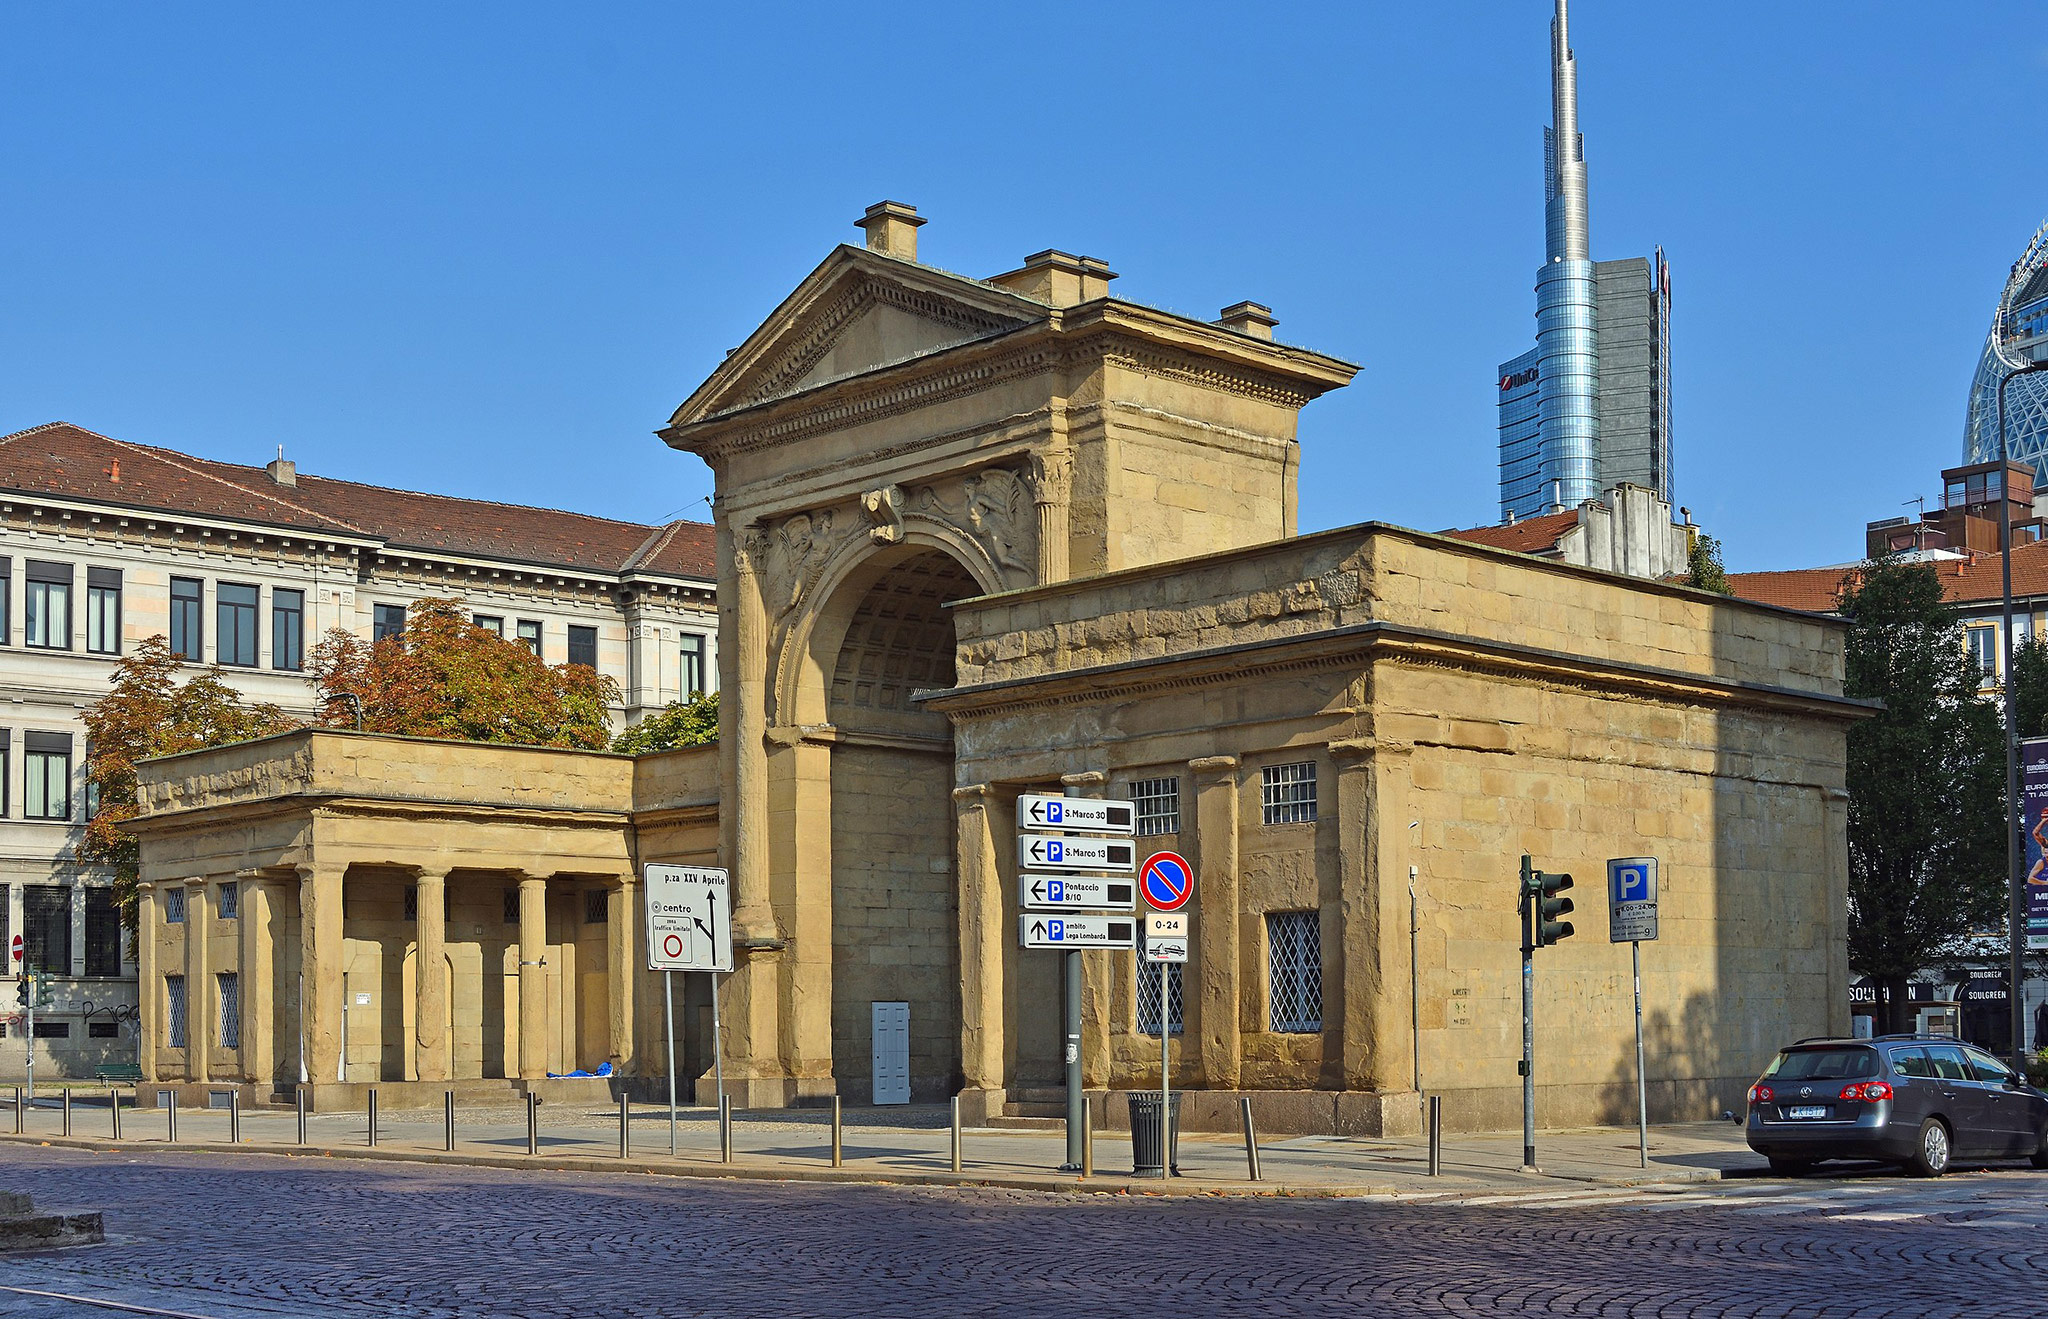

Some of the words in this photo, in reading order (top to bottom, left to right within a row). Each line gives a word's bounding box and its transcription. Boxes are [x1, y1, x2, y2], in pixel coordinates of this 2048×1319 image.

[1051, 805, 1060, 819] P
[1095, 811, 1106, 820] 30
[1051, 845, 1060, 859] P
[1097, 850, 1106, 858] 13
[664, 874, 680, 883] p.za
[683, 872, 698, 883] XXV
[702, 874, 725, 886] Aprile
[1620, 869, 1641, 898] P
[1051, 884, 1061, 898] P
[1065, 883, 1099, 891] Pontaccio
[1065, 893, 1082, 901] 8/10
[663, 903, 692, 913] centro
[1052, 923, 1061, 937] P
[1066, 922, 1086, 930] ambito
[1155, 920, 1179, 929] 0-24
[1066, 932, 1079, 940] Lega
[1079, 932, 1106, 940] Lombarda
[1969, 971, 2002, 979] SOULGREEN
[1968, 990, 2007, 1000] SOULGREEN
